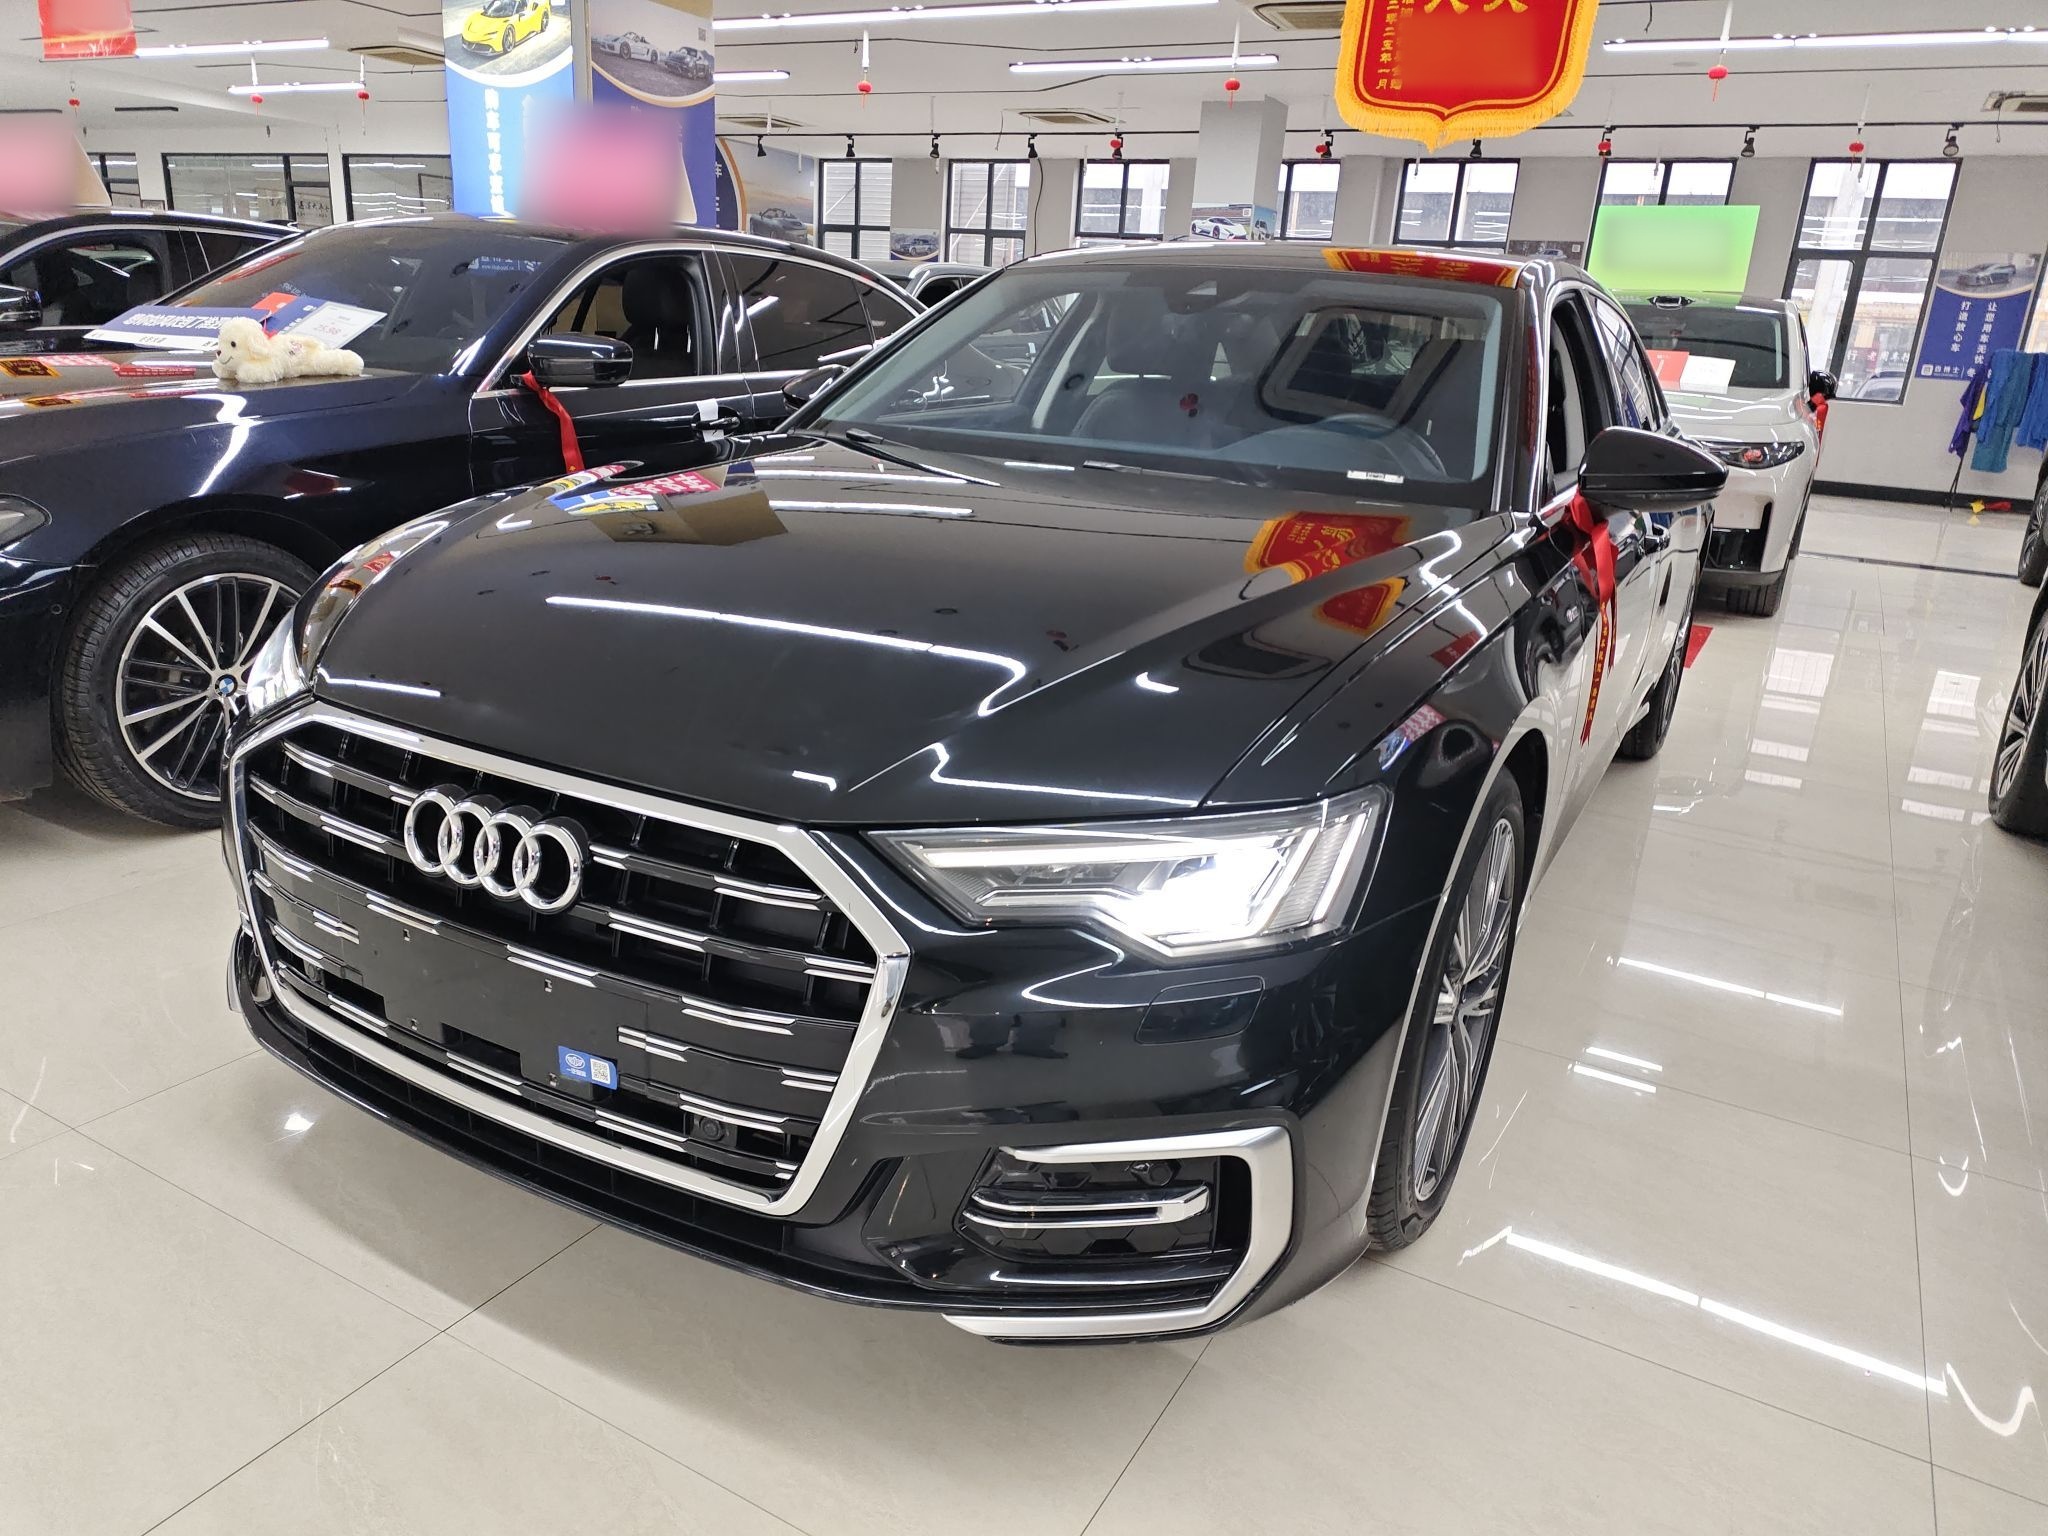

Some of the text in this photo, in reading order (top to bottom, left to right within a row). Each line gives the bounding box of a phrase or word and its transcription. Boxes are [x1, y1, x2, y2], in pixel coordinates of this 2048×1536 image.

[1951, 301, 1972, 352] 打造放心车
